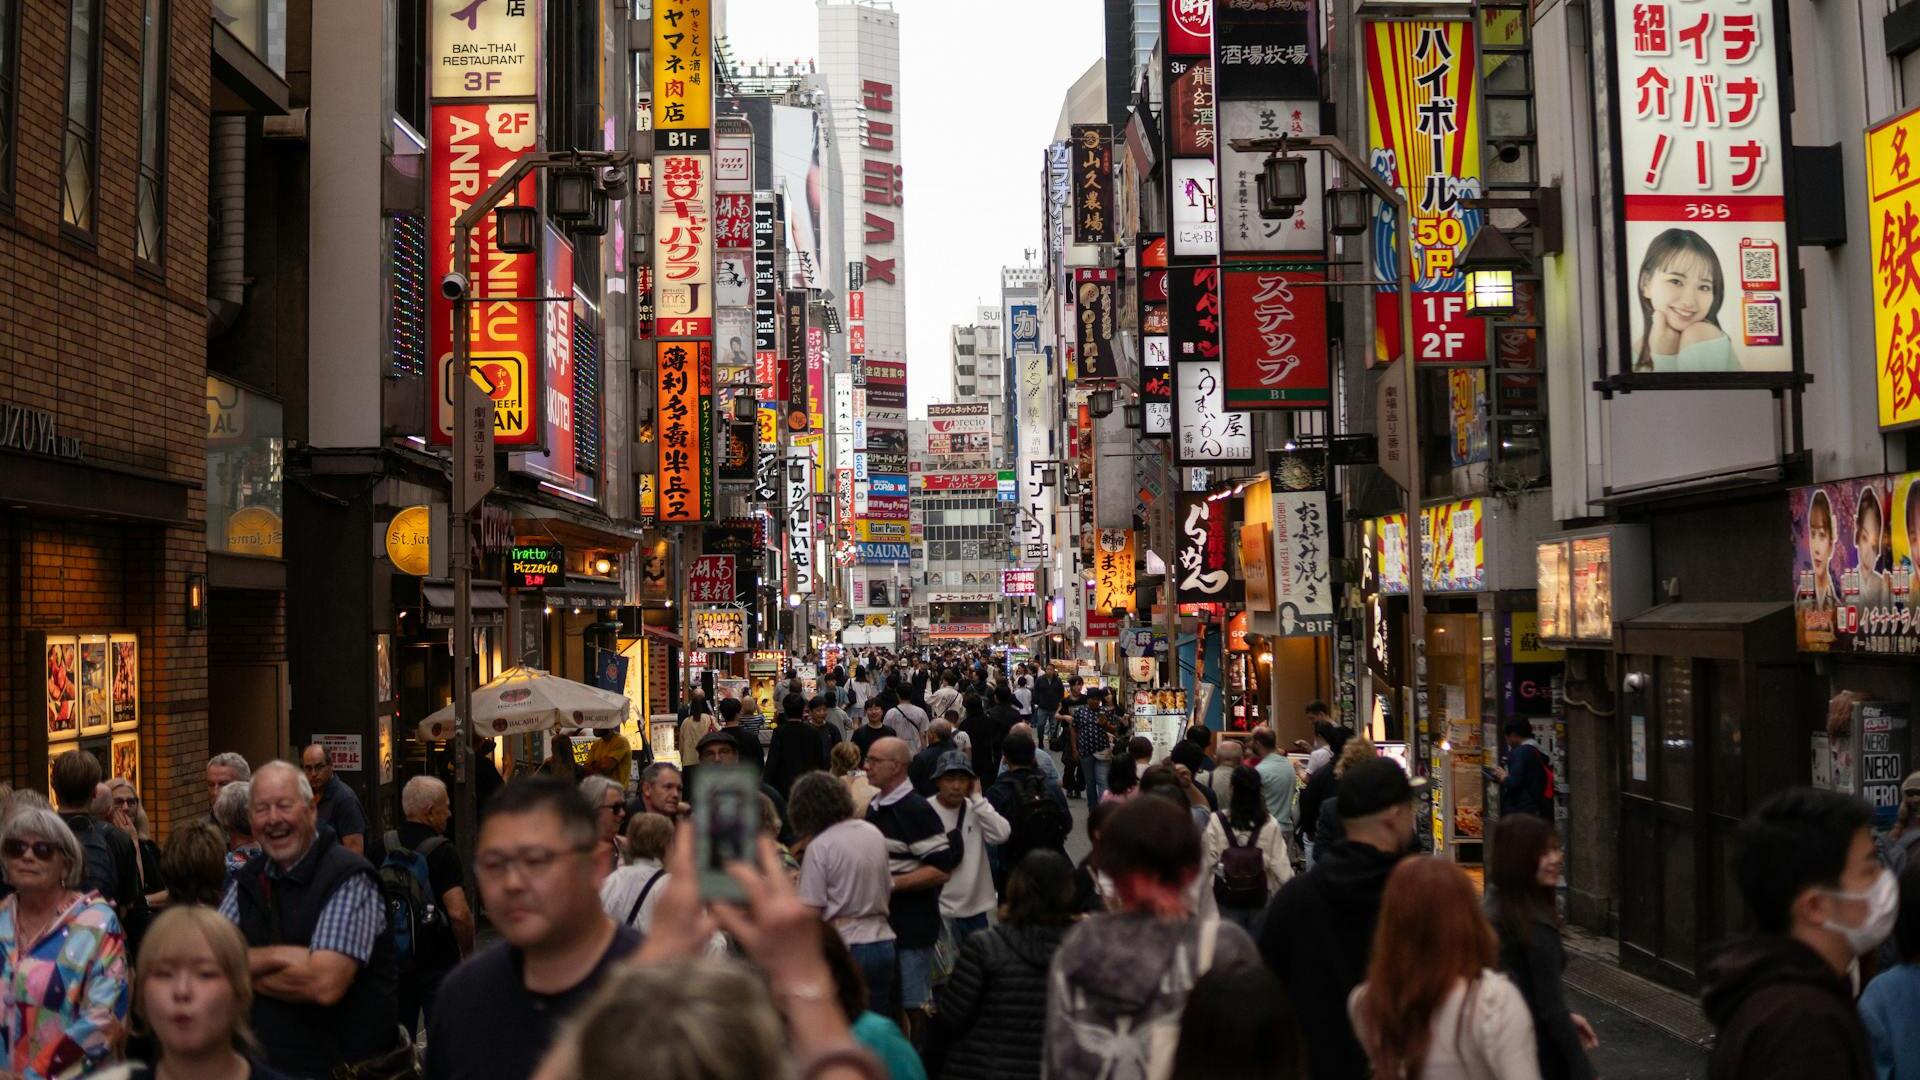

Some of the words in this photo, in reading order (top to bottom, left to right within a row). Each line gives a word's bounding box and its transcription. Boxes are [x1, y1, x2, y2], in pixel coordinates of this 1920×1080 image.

[452, 43, 516, 54] BAN-THAI
[689, 8, 702, 86] やきとん酒場
[1221, 45, 1309, 65] 酒場牧場
[442, 55, 525, 66] RESTAURANT
[1171, 61, 1187, 74] 3F
[464, 72, 502, 91] 3F
[498, 113, 529, 133] 2F
[1412, 27, 1460, 214] ハイボール
[668, 131, 697, 147] B1F
[1684, 203, 1732, 219] うらら
[1088, 234, 1102, 242] 5F
[1424, 248, 1455, 278] 円
[1422, 297, 1464, 323] 1F
[670, 319, 698, 336] 4F
[1253, 275, 1301, 386] ステップ
[1422, 332, 1465, 358] 2F
[1271, 390, 1286, 400] B1
[1221, 413, 1247, 438] 屋
[473, 406, 485, 482] 劇場通り一番街
[1183, 424, 1195, 459] 一番街
[1226, 447, 1250, 458] B1F
[867, 544, 909, 558] SAUNA
[1277, 502, 1289, 543] HIROSHIMA
[1283, 548, 1293, 597] TEPPANYAKI
[1293, 501, 1329, 603] お好み焼き
[513, 560, 559, 574] Pizzeria
[525, 575, 545, 586] Bar
[1006, 572, 1035, 582] 24時間
[1100, 553, 1119, 609] まっちゃん
[1306, 620, 1332, 633] B1F
[1136, 705, 1147, 713] 4F
[1863, 733, 1889, 752] NERO
[1864, 755, 1899, 780] NERO
